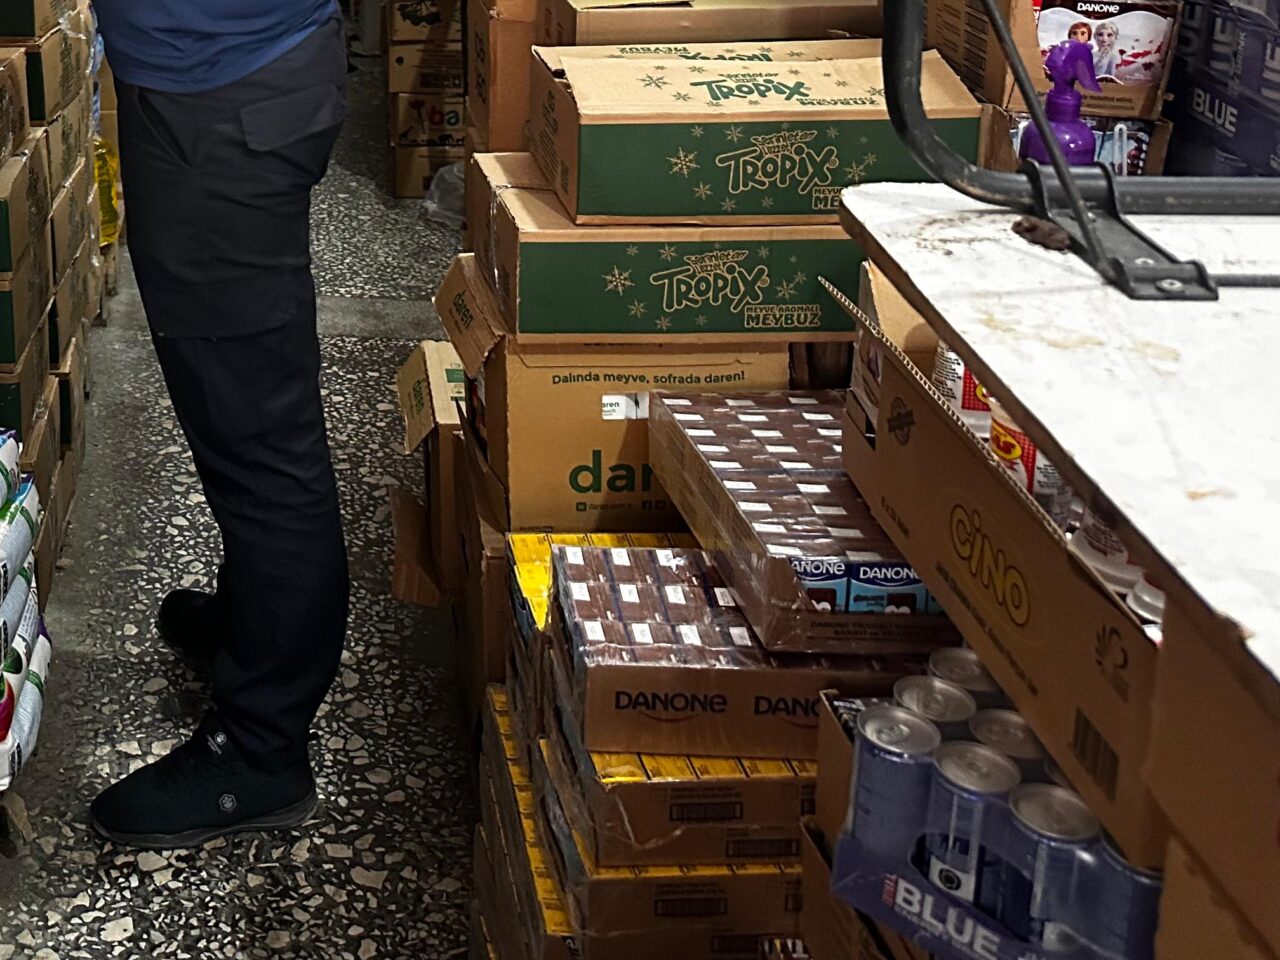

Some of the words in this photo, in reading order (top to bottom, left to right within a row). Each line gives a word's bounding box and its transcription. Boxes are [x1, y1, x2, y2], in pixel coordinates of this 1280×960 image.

[1077, 1, 1119, 14] DANONE
[1193, 91, 1238, 136] BLUE
[452, 289, 475, 330] daren
[746, 305, 776, 313] MEYVE
[745, 313, 820, 327] MEYBUZ
[552, 371, 600, 385] Dalında
[603, 374, 650, 386] meyve,
[653, 372, 701, 384] sofrada
[704, 370, 745, 384] daren!
[570, 450, 654, 493] dar
[614, 691, 727, 713] DANONE
[754, 695, 821, 715] DANO
[894, 878, 1002, 958] BLUE
